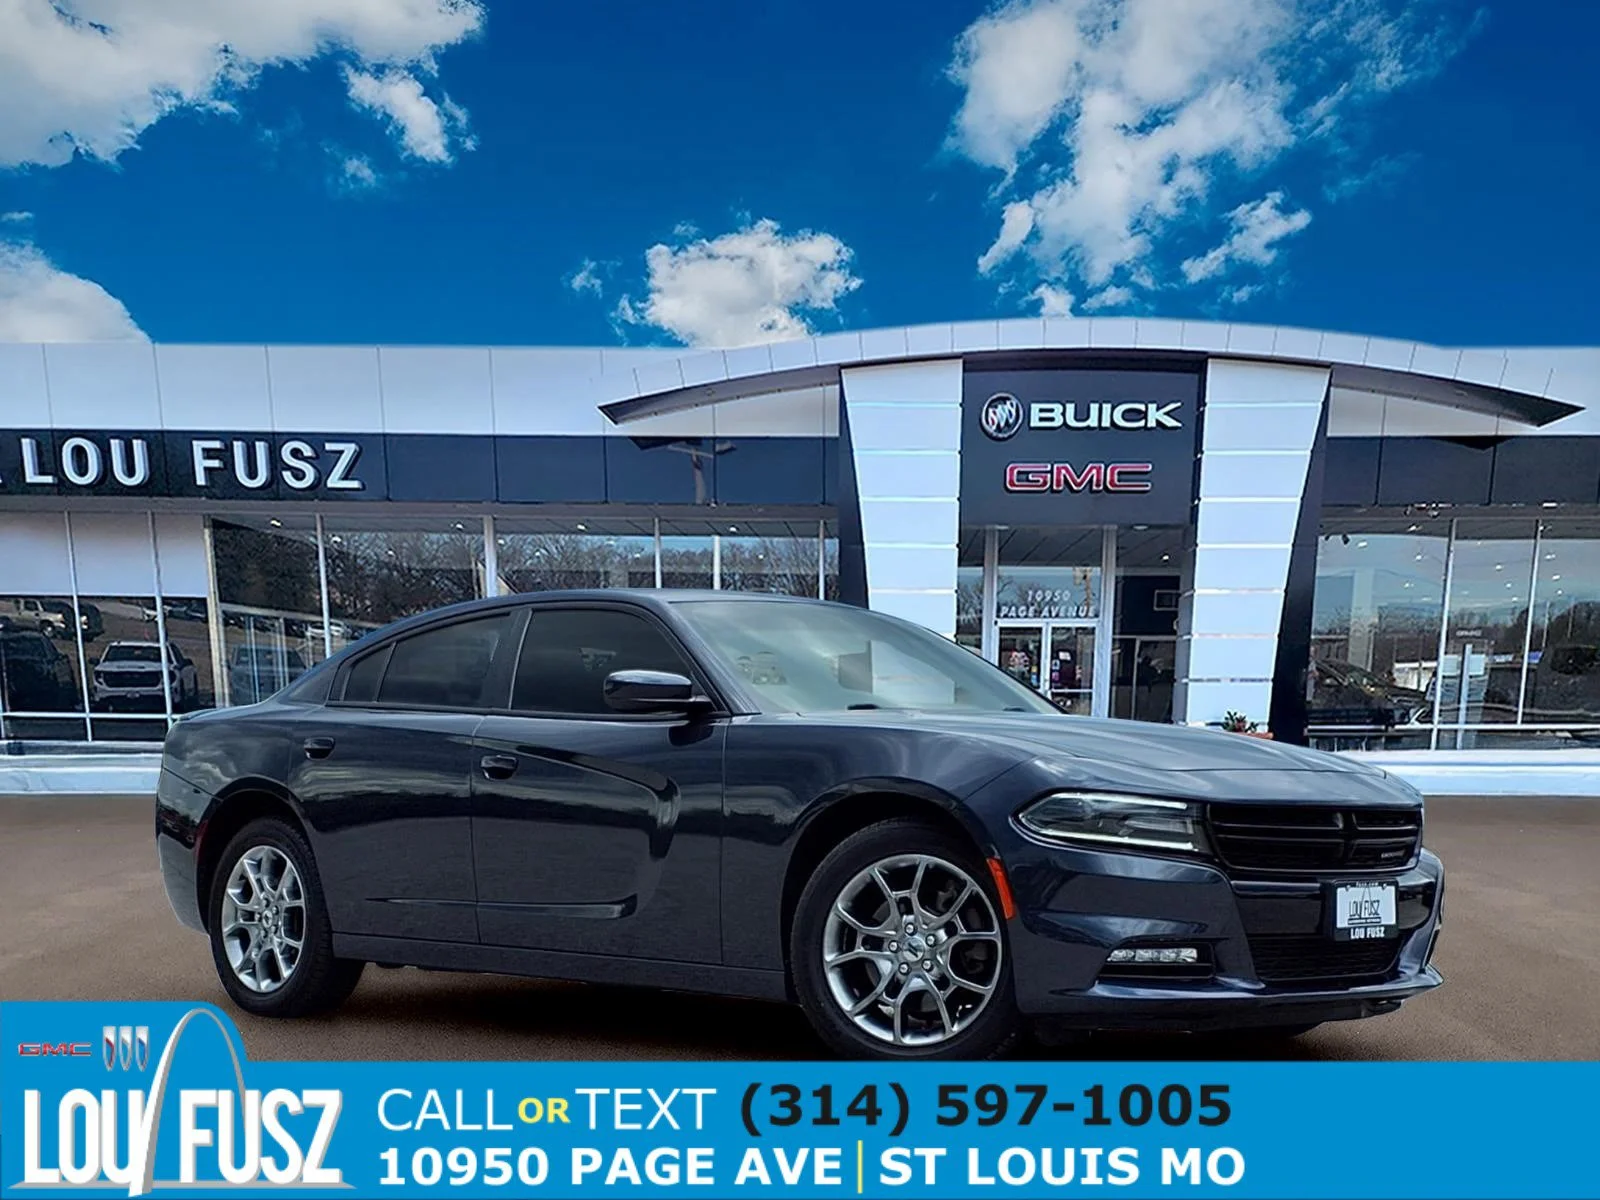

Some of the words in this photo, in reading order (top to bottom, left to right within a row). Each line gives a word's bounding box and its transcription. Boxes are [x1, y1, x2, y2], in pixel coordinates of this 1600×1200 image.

[1029, 402, 1183, 429] BUICK
[20, 437, 151, 487] LOU
[191, 439, 365, 491] FUSZ
[1005, 463, 1152, 491] GMC
[1027, 590, 1071, 601] 10950
[1000, 605, 1036, 617] PAGE
[1040, 605, 1095, 617] AVENUE
[1350, 927, 1365, 939] LOU
[1366, 926, 1385, 938] FUSZ
